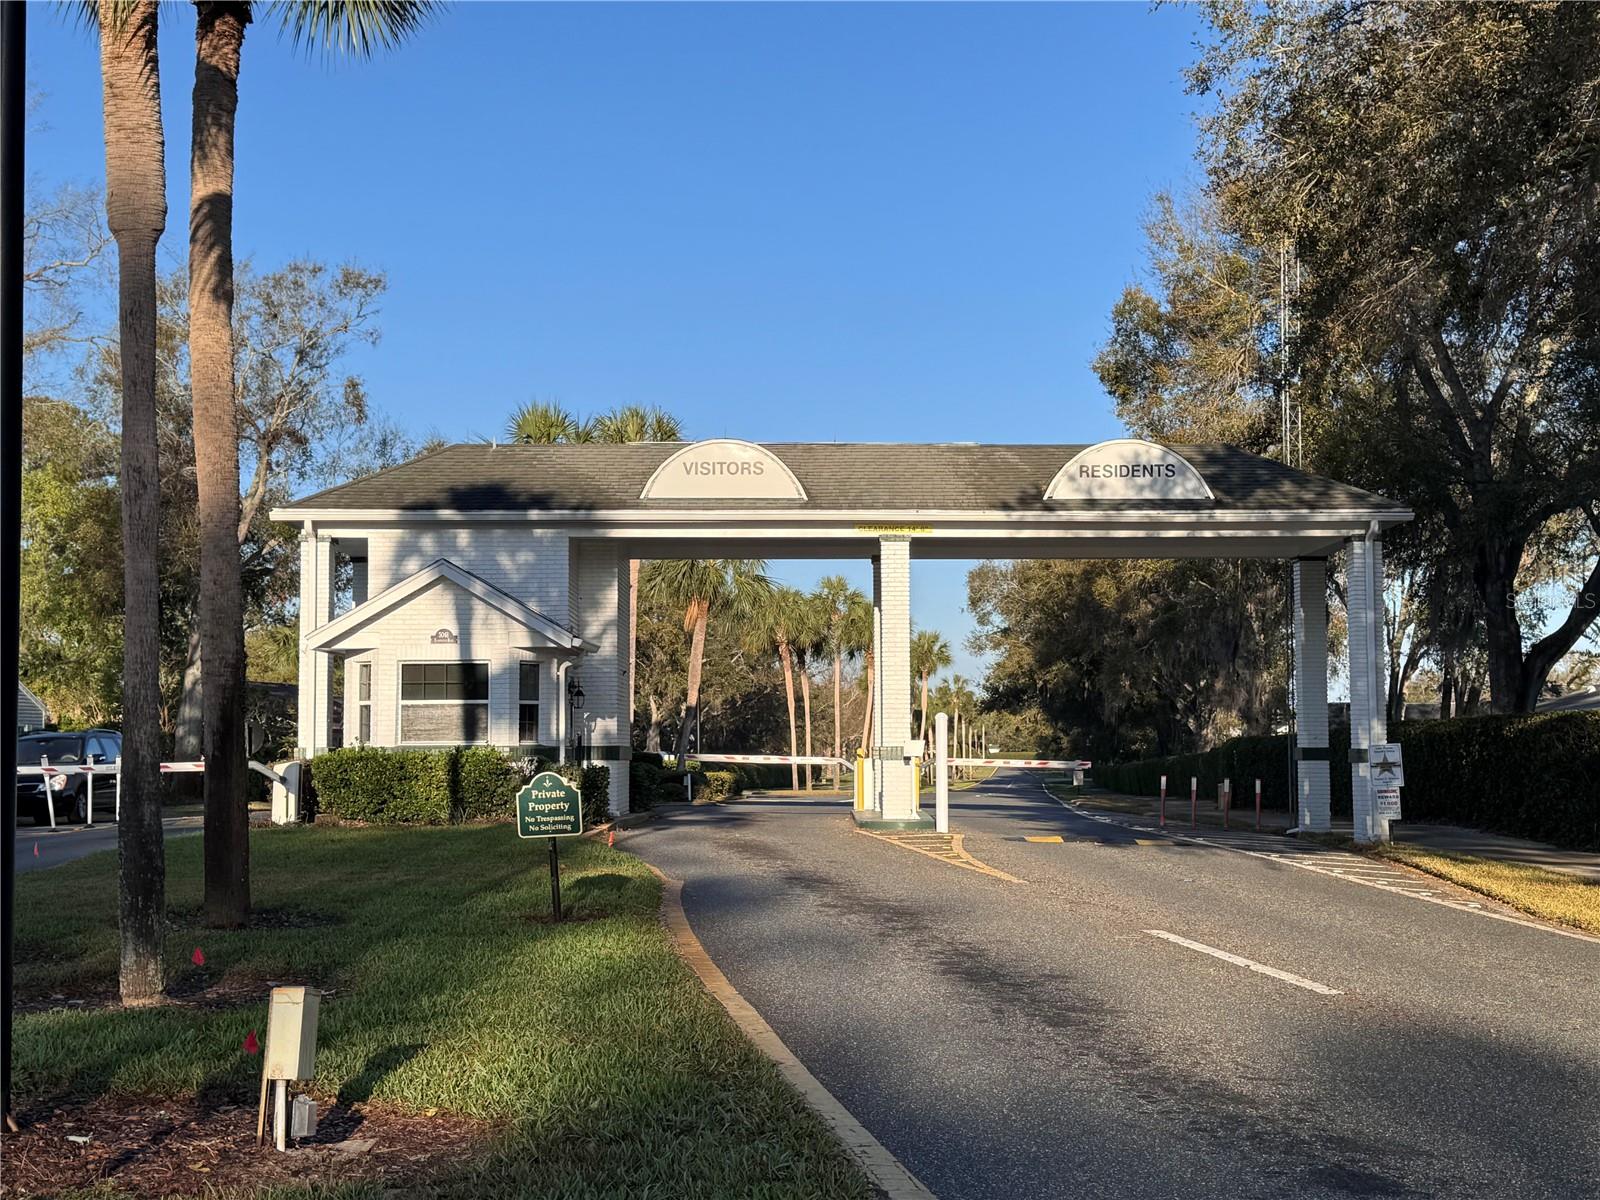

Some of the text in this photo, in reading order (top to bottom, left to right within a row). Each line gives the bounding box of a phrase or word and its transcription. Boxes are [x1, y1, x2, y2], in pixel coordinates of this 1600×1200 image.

[682, 461, 765, 476] VISITORS
[1079, 463, 1176, 479] RESIDENTS
[531, 790, 566, 799] Private
[528, 802, 570, 813] Property
[536, 815, 575, 823] Trespassing
